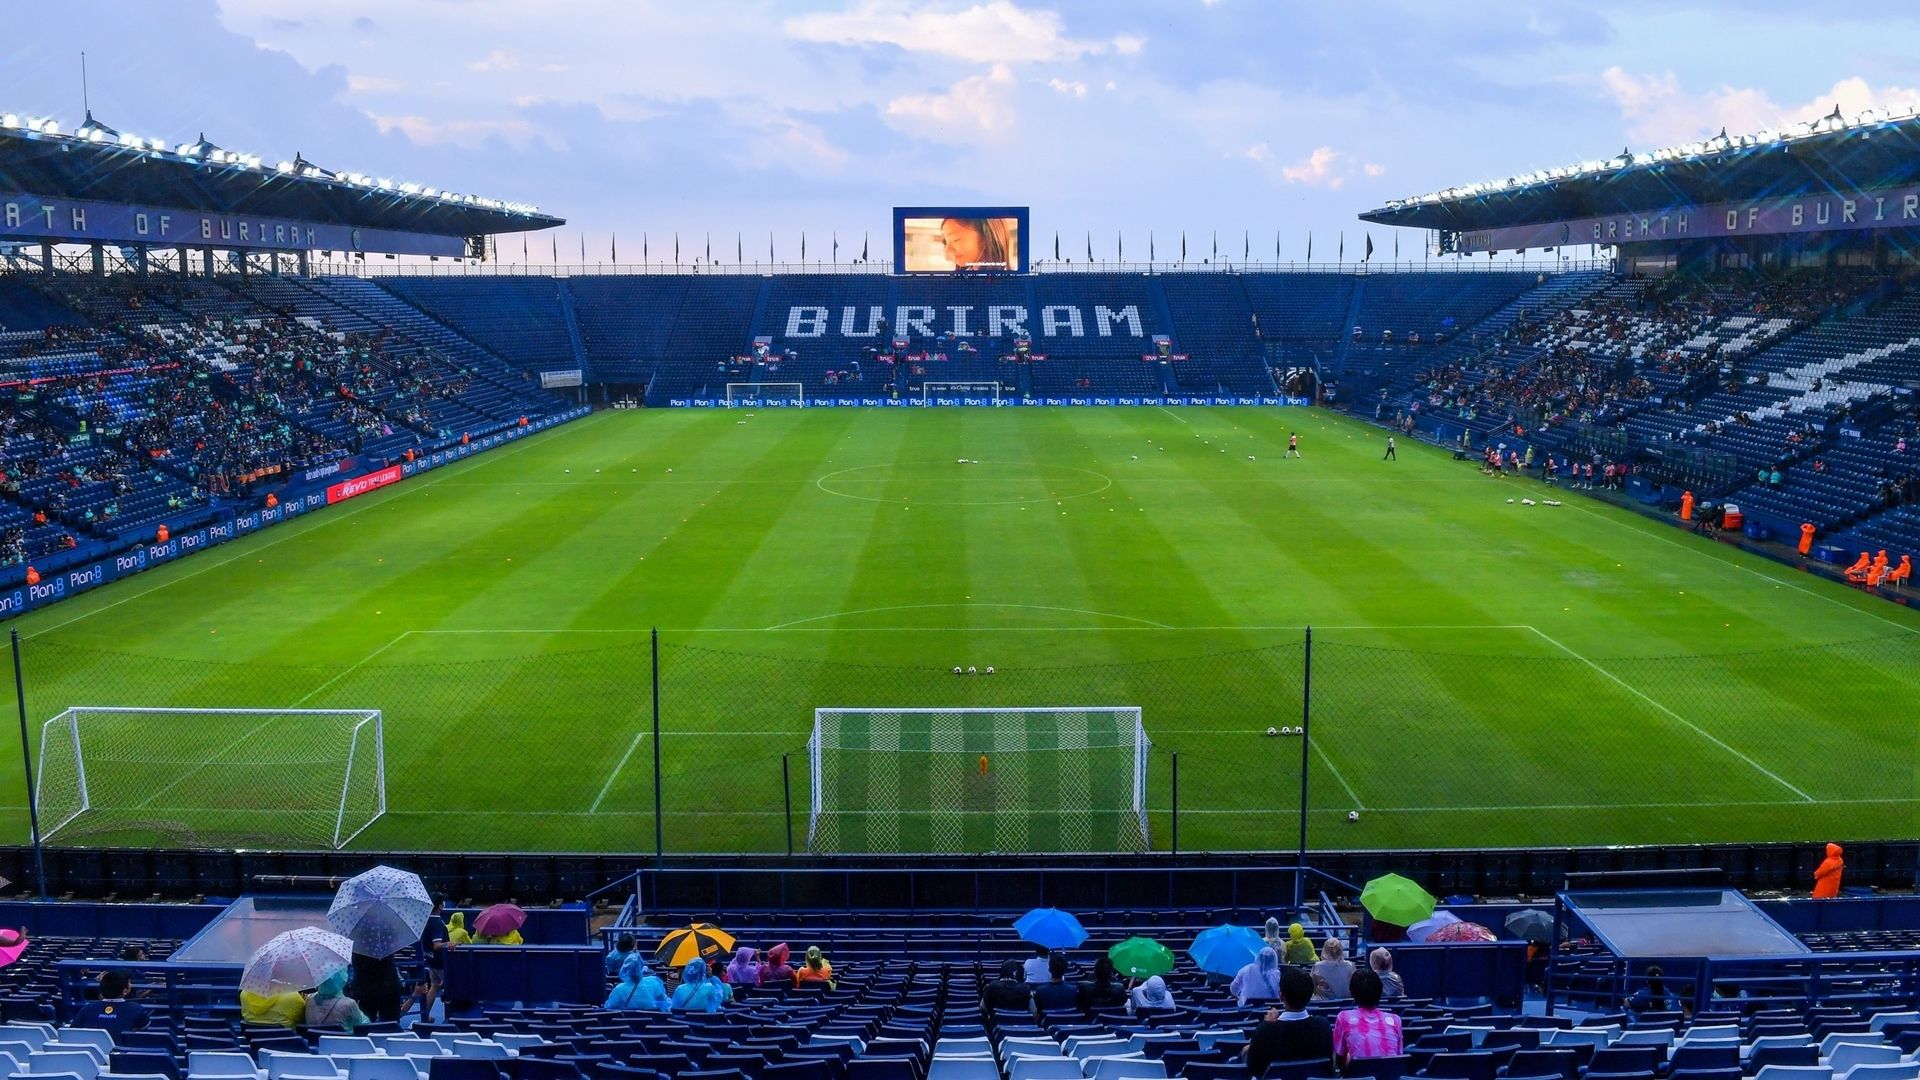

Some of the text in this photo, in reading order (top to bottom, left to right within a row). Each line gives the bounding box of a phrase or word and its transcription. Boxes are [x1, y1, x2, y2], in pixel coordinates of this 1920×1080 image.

[5, 202, 316, 246] ATH OF BURIRAM
[1593, 194, 1919, 240] BREATH OF BURIR
[785, 305, 1144, 338] BURIRAM
